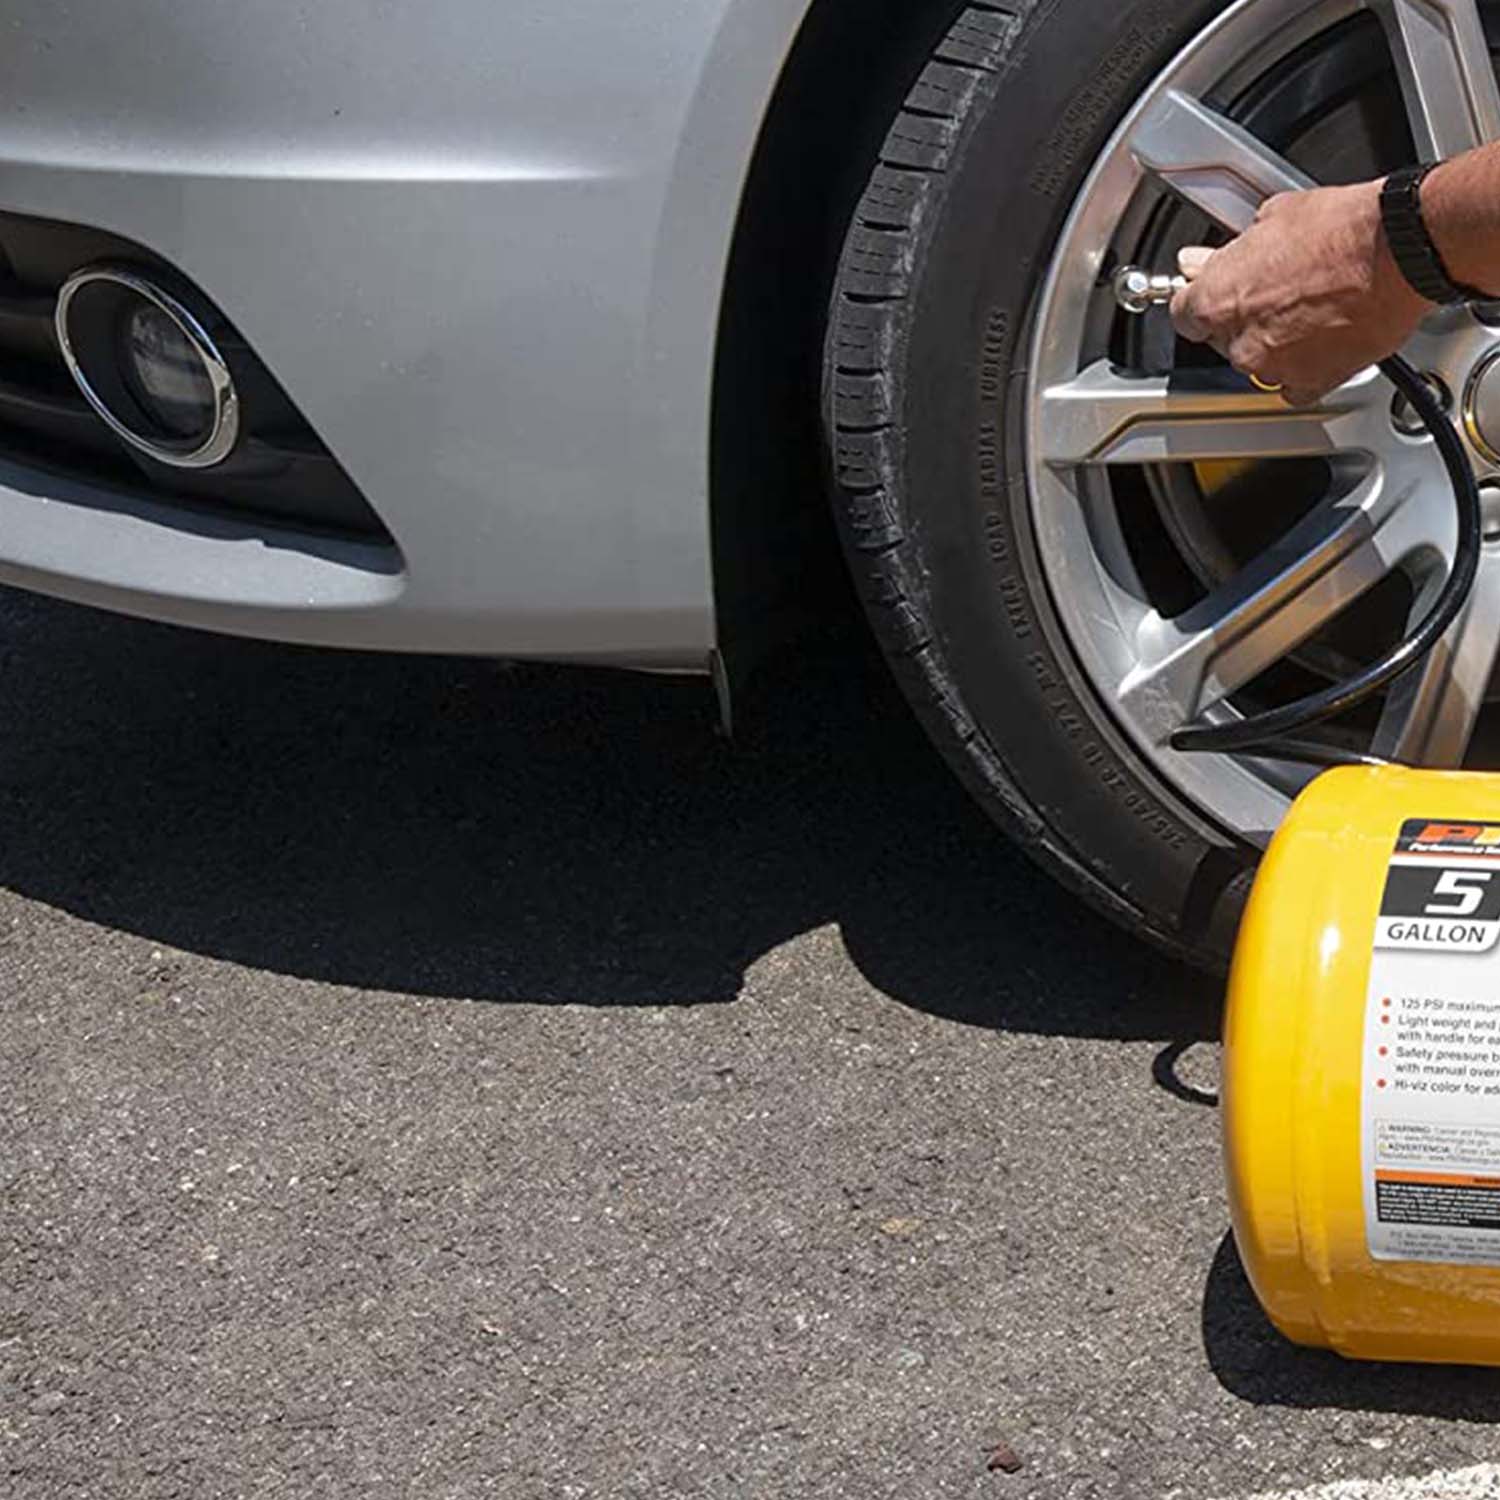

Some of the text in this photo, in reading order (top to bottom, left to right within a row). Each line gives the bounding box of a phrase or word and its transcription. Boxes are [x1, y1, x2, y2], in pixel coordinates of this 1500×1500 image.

[980, 310, 1008, 403] TUBELESS
[978, 424, 999, 498] RADIAL
[1424, 868, 1492, 916] 5
[1387, 922, 1486, 944] GALLON
[1401, 999, 1420, 1009] 125
[1424, 999, 1443, 1010] PSI
[1398, 1015, 1429, 1028] Light
[1432, 1017, 1471, 1030] weight
[1474, 1019, 1496, 1030] and
[1397, 1031, 1422, 1041] with
[1425, 1033, 1464, 1043] handle
[1468, 1034, 1485, 1044] for
[1396, 1046, 1432, 1061] Safety
[1436, 1050, 1488, 1062] pressure
[1395, 1064, 1420, 1073] with
[1423, 1066, 1466, 1076] manual
[1394, 1080, 1427, 1091] Hi-viz
[1430, 1081, 1461, 1093] color
[1464, 1083, 1480, 1094] for
